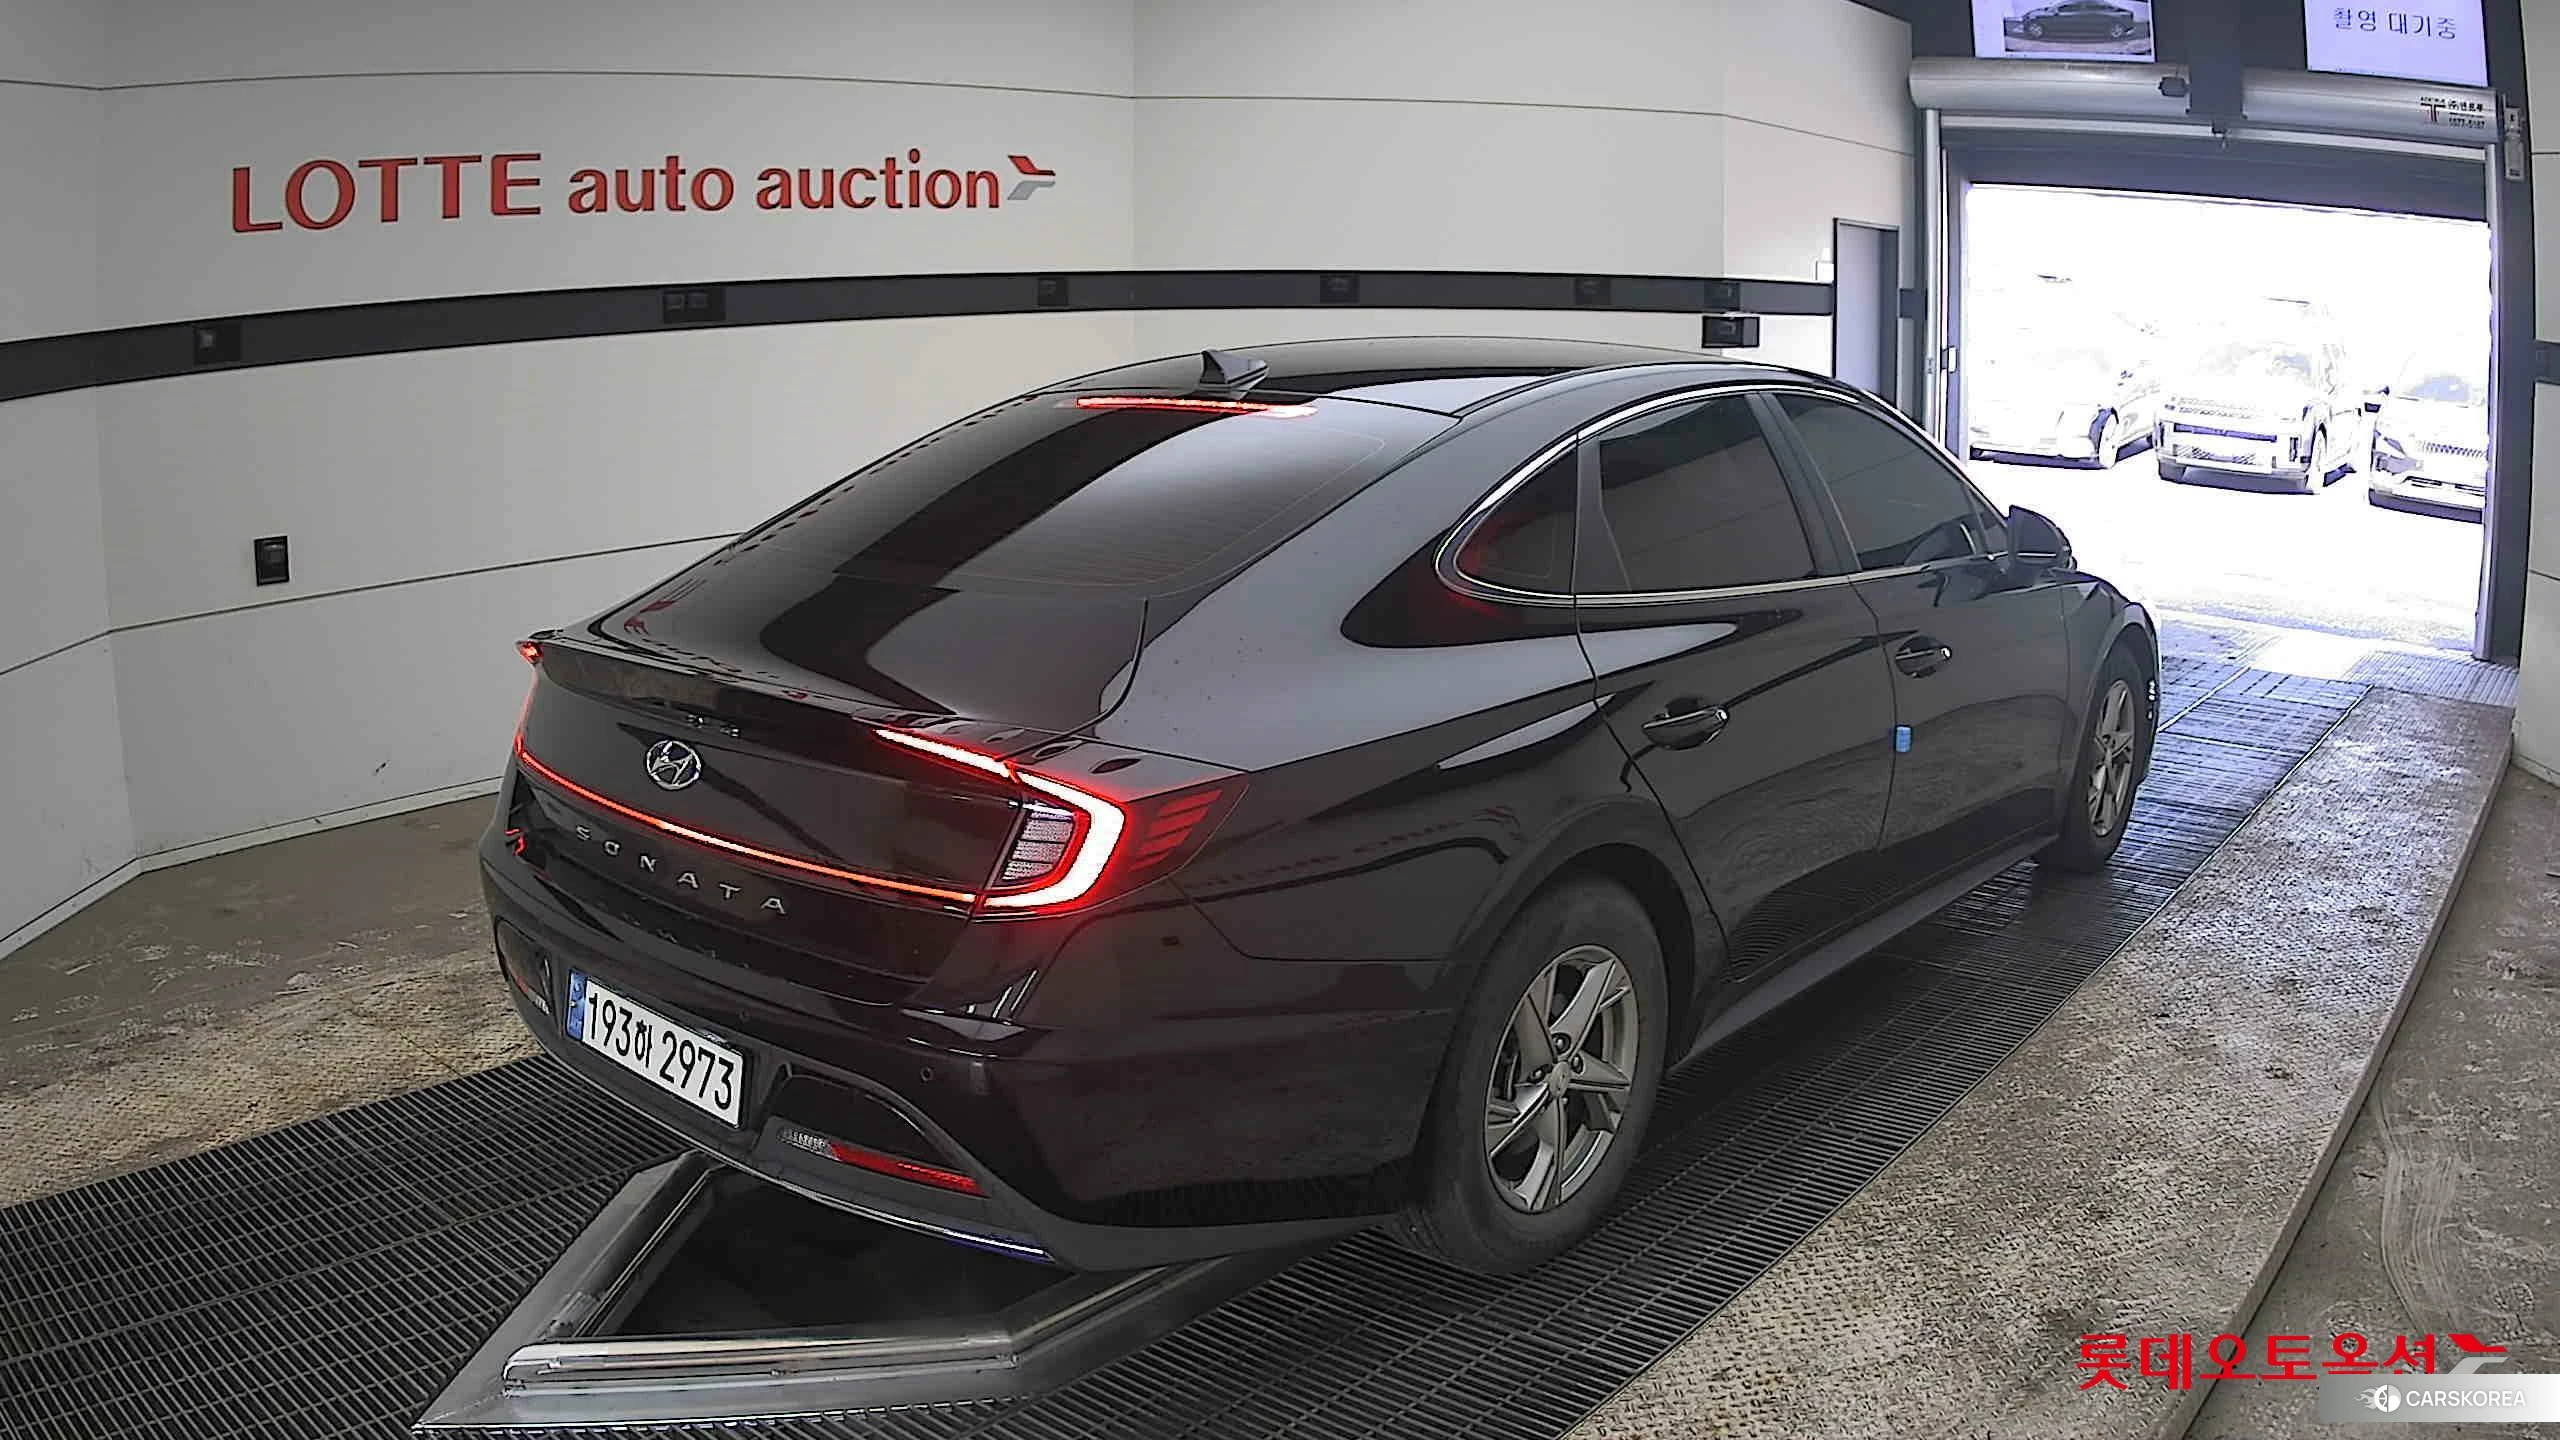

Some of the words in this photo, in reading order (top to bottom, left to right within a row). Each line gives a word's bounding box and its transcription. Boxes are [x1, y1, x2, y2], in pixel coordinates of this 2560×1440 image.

[2389, 13, 2457, 40] 대기중
[232, 153, 543, 233] LOTTE
[568, 155, 735, 213] auto
[755, 148, 1001, 210] auction
[575, 824, 788, 915] SONATA
[589, 993, 653, 1068] 193하
[659, 1030, 734, 1110] 2973
